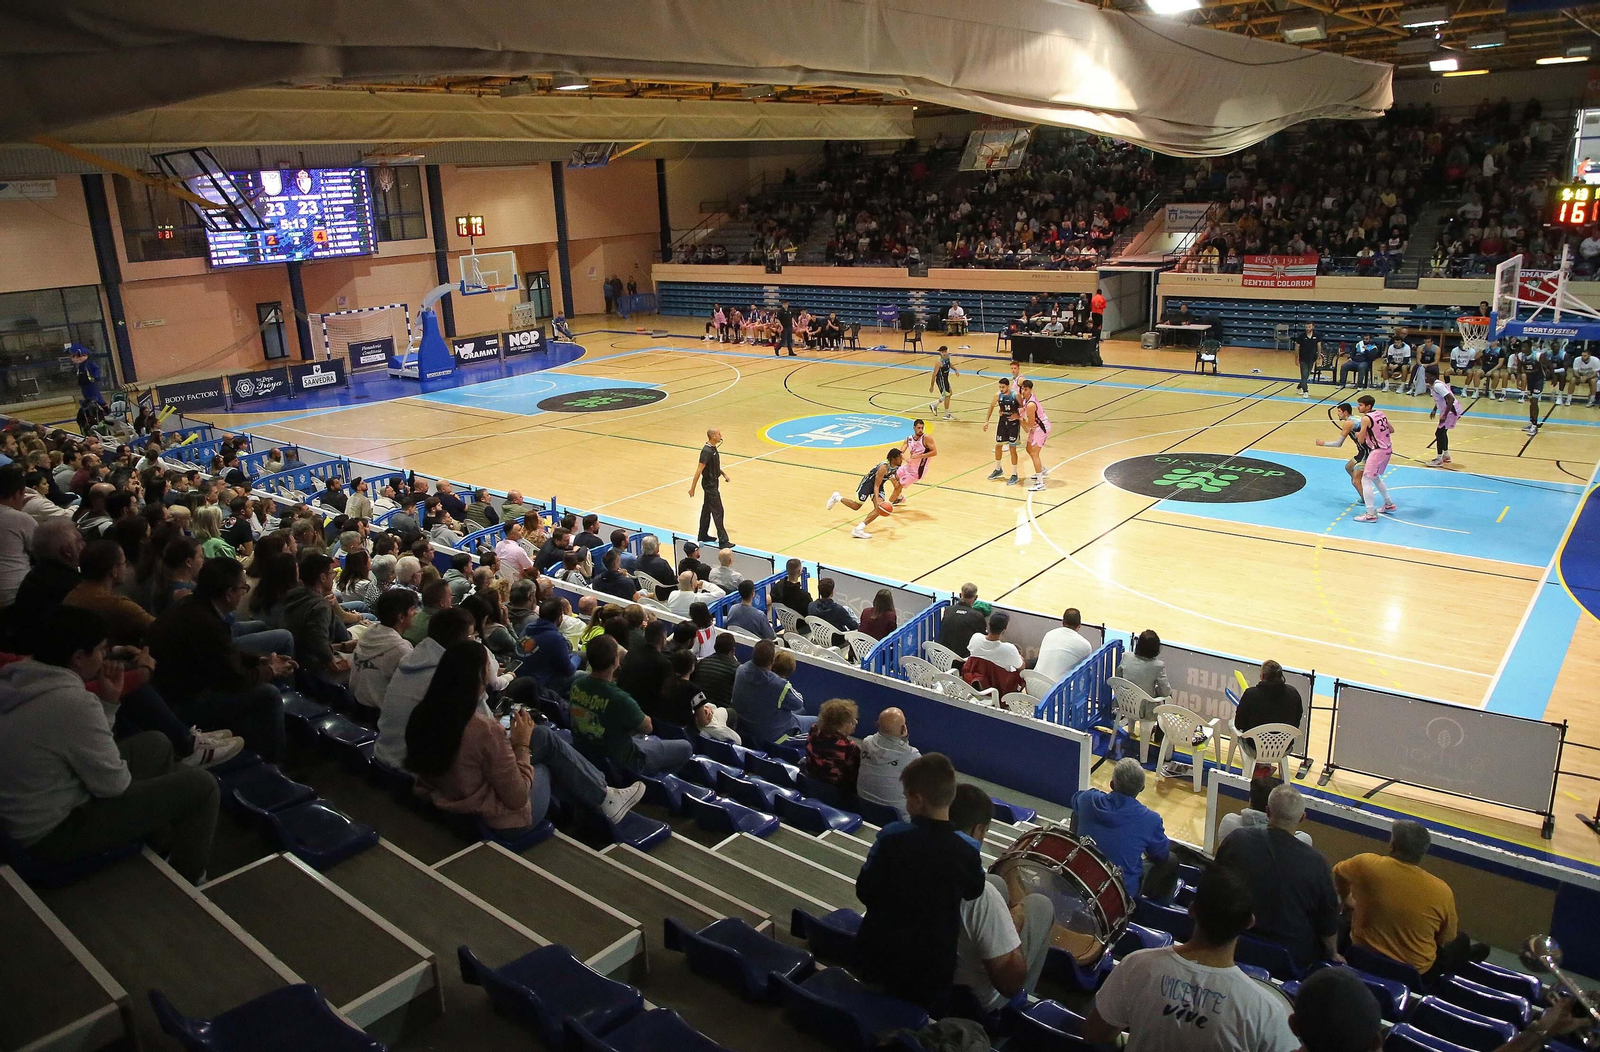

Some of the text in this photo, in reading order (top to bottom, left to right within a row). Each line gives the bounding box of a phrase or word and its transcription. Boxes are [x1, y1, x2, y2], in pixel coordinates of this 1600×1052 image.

[266, 201, 318, 216] 23 23
[1559, 201, 1586, 223] 16
[280, 217, 307, 229] 5:13
[472, 223, 483, 234] 16
[267, 231, 323, 245] 2 2 4
[1255, 256, 1278, 264] PEÑA
[508, 330, 540, 347] NOP
[304, 375, 335, 386] SAAVEDRA
[165, 390, 219, 404] BODY FACTORY
[1154, 456, 1286, 477] damex.io
